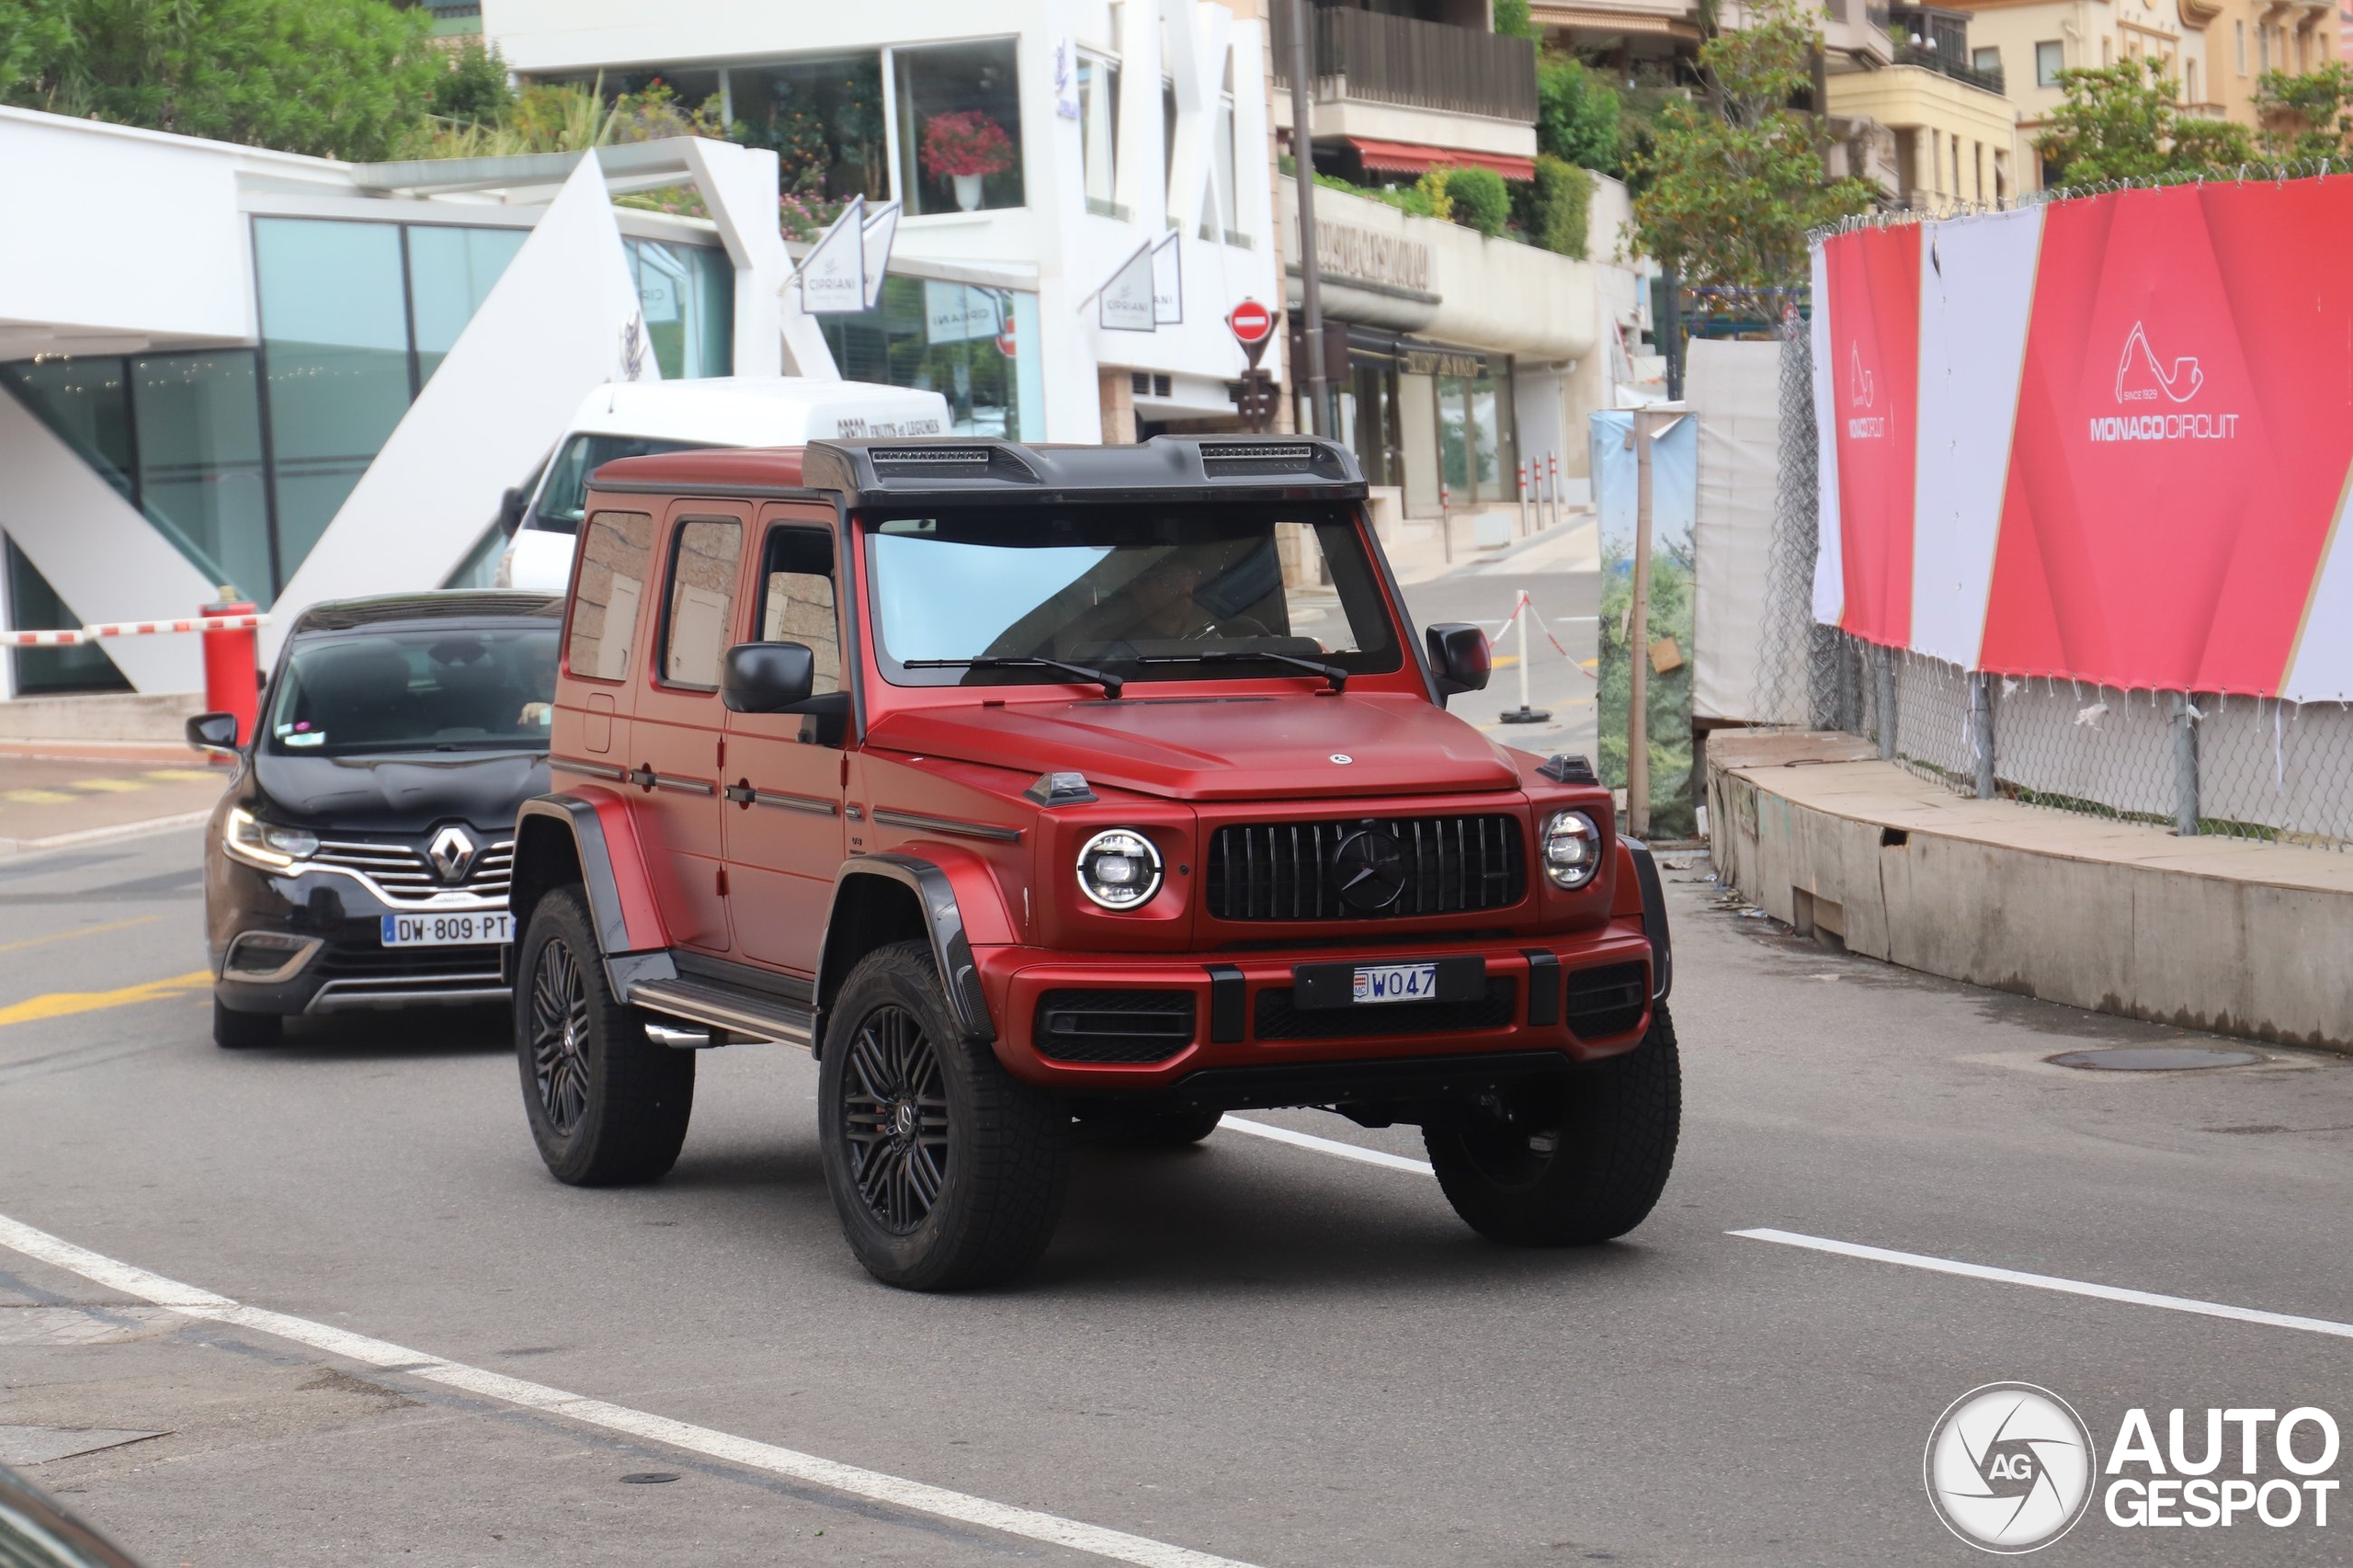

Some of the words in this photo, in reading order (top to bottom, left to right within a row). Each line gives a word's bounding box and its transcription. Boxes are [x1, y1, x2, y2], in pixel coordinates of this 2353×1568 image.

[809, 278, 856, 290] CIPRIANI
[1107, 300, 1148, 312] CIPRIANI
[2124, 391, 2142, 401] SINCE
[2143, 389, 2157, 400] 1929
[399, 916, 507, 941] DW-809-PT
